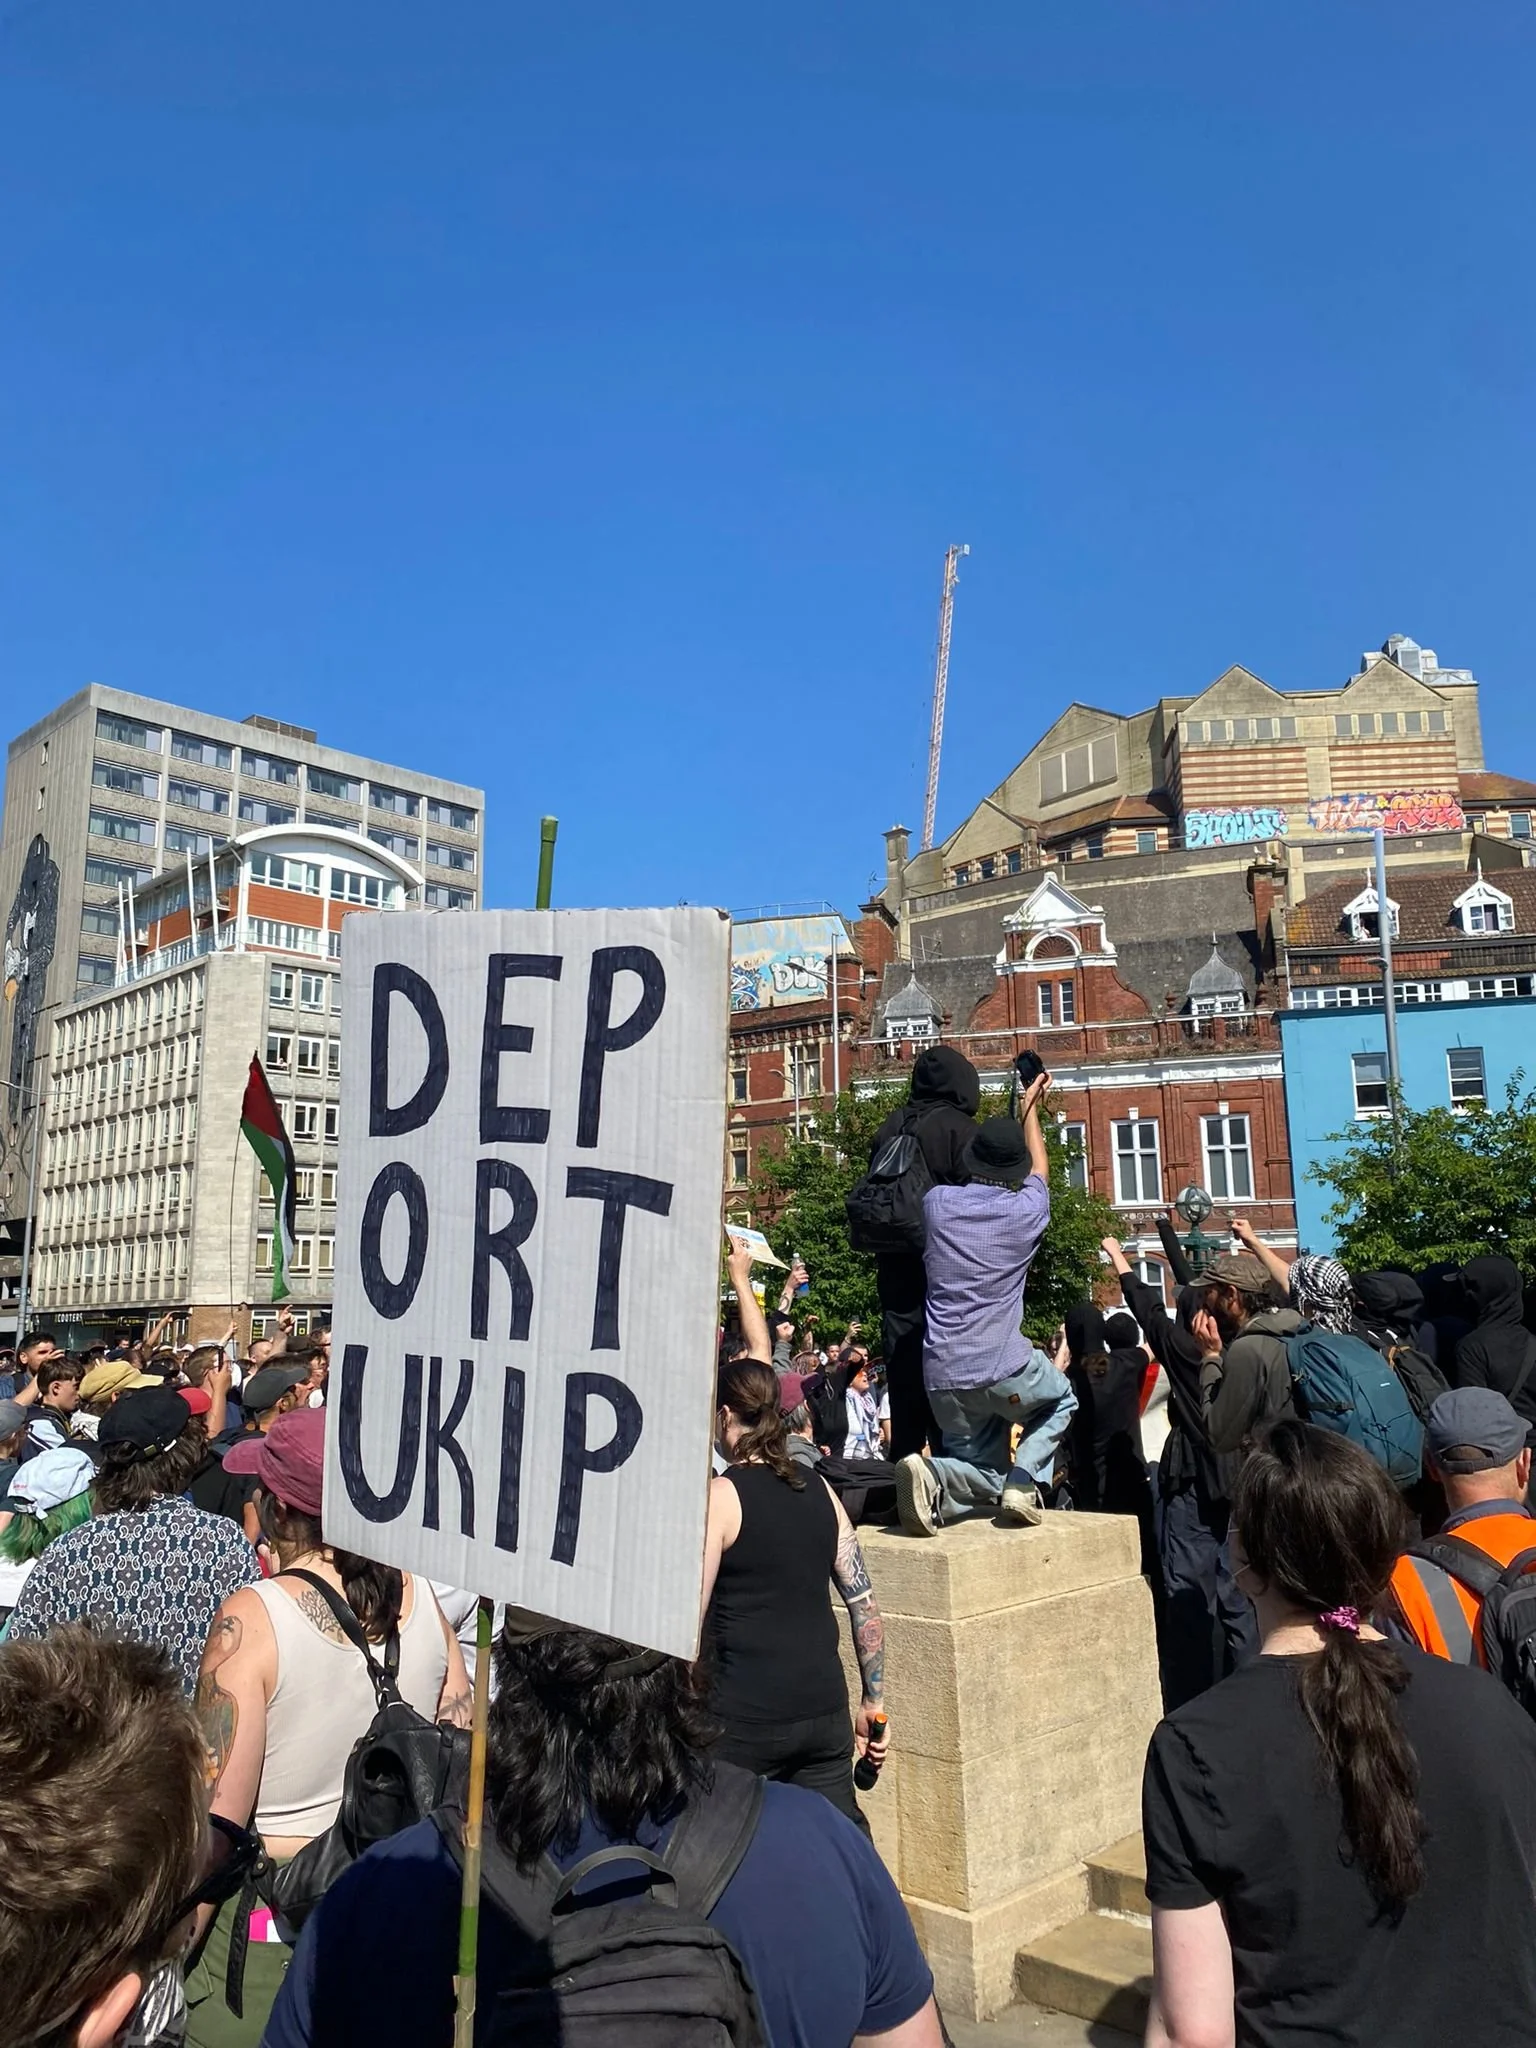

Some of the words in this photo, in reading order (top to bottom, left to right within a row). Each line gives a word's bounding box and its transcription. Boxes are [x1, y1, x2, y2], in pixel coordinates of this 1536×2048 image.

[370, 946, 666, 1148] DEP
[360, 1158, 674, 1350] ORT
[339, 1344, 643, 1566] UKIP
